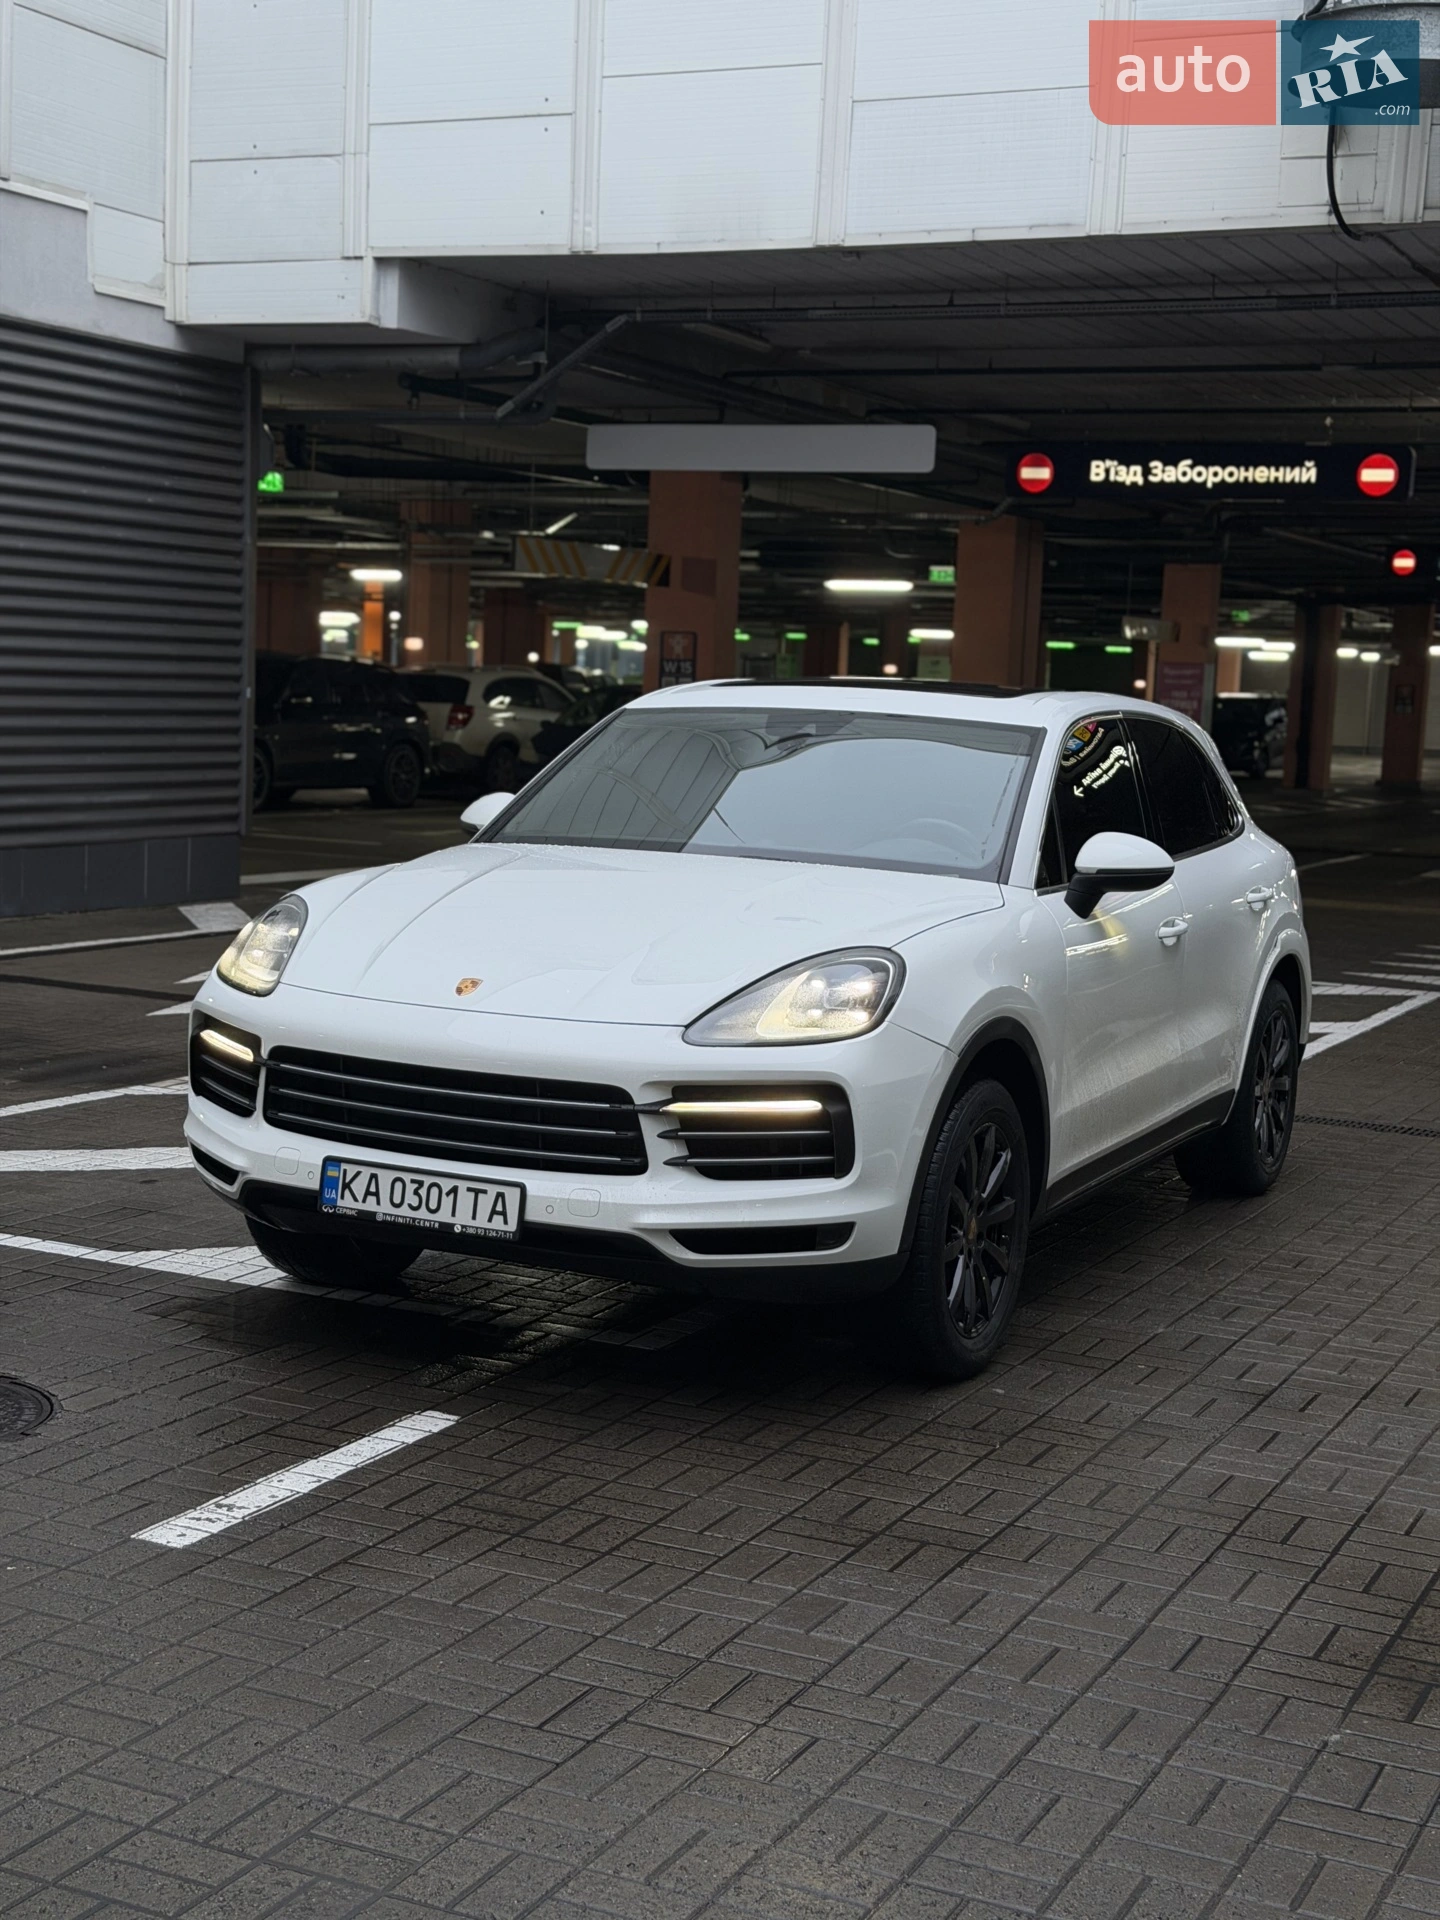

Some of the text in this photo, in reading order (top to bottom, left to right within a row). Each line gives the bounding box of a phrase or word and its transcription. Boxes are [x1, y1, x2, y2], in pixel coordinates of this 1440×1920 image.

[1089, 459, 1317, 488] В'їзд Заборонений
[324, 1188, 337, 1199] UA
[389, 1176, 459, 1218] 0301
[335, 1206, 359, 1217] СЕРВИС
[462, 1226, 476, 1234] +380
